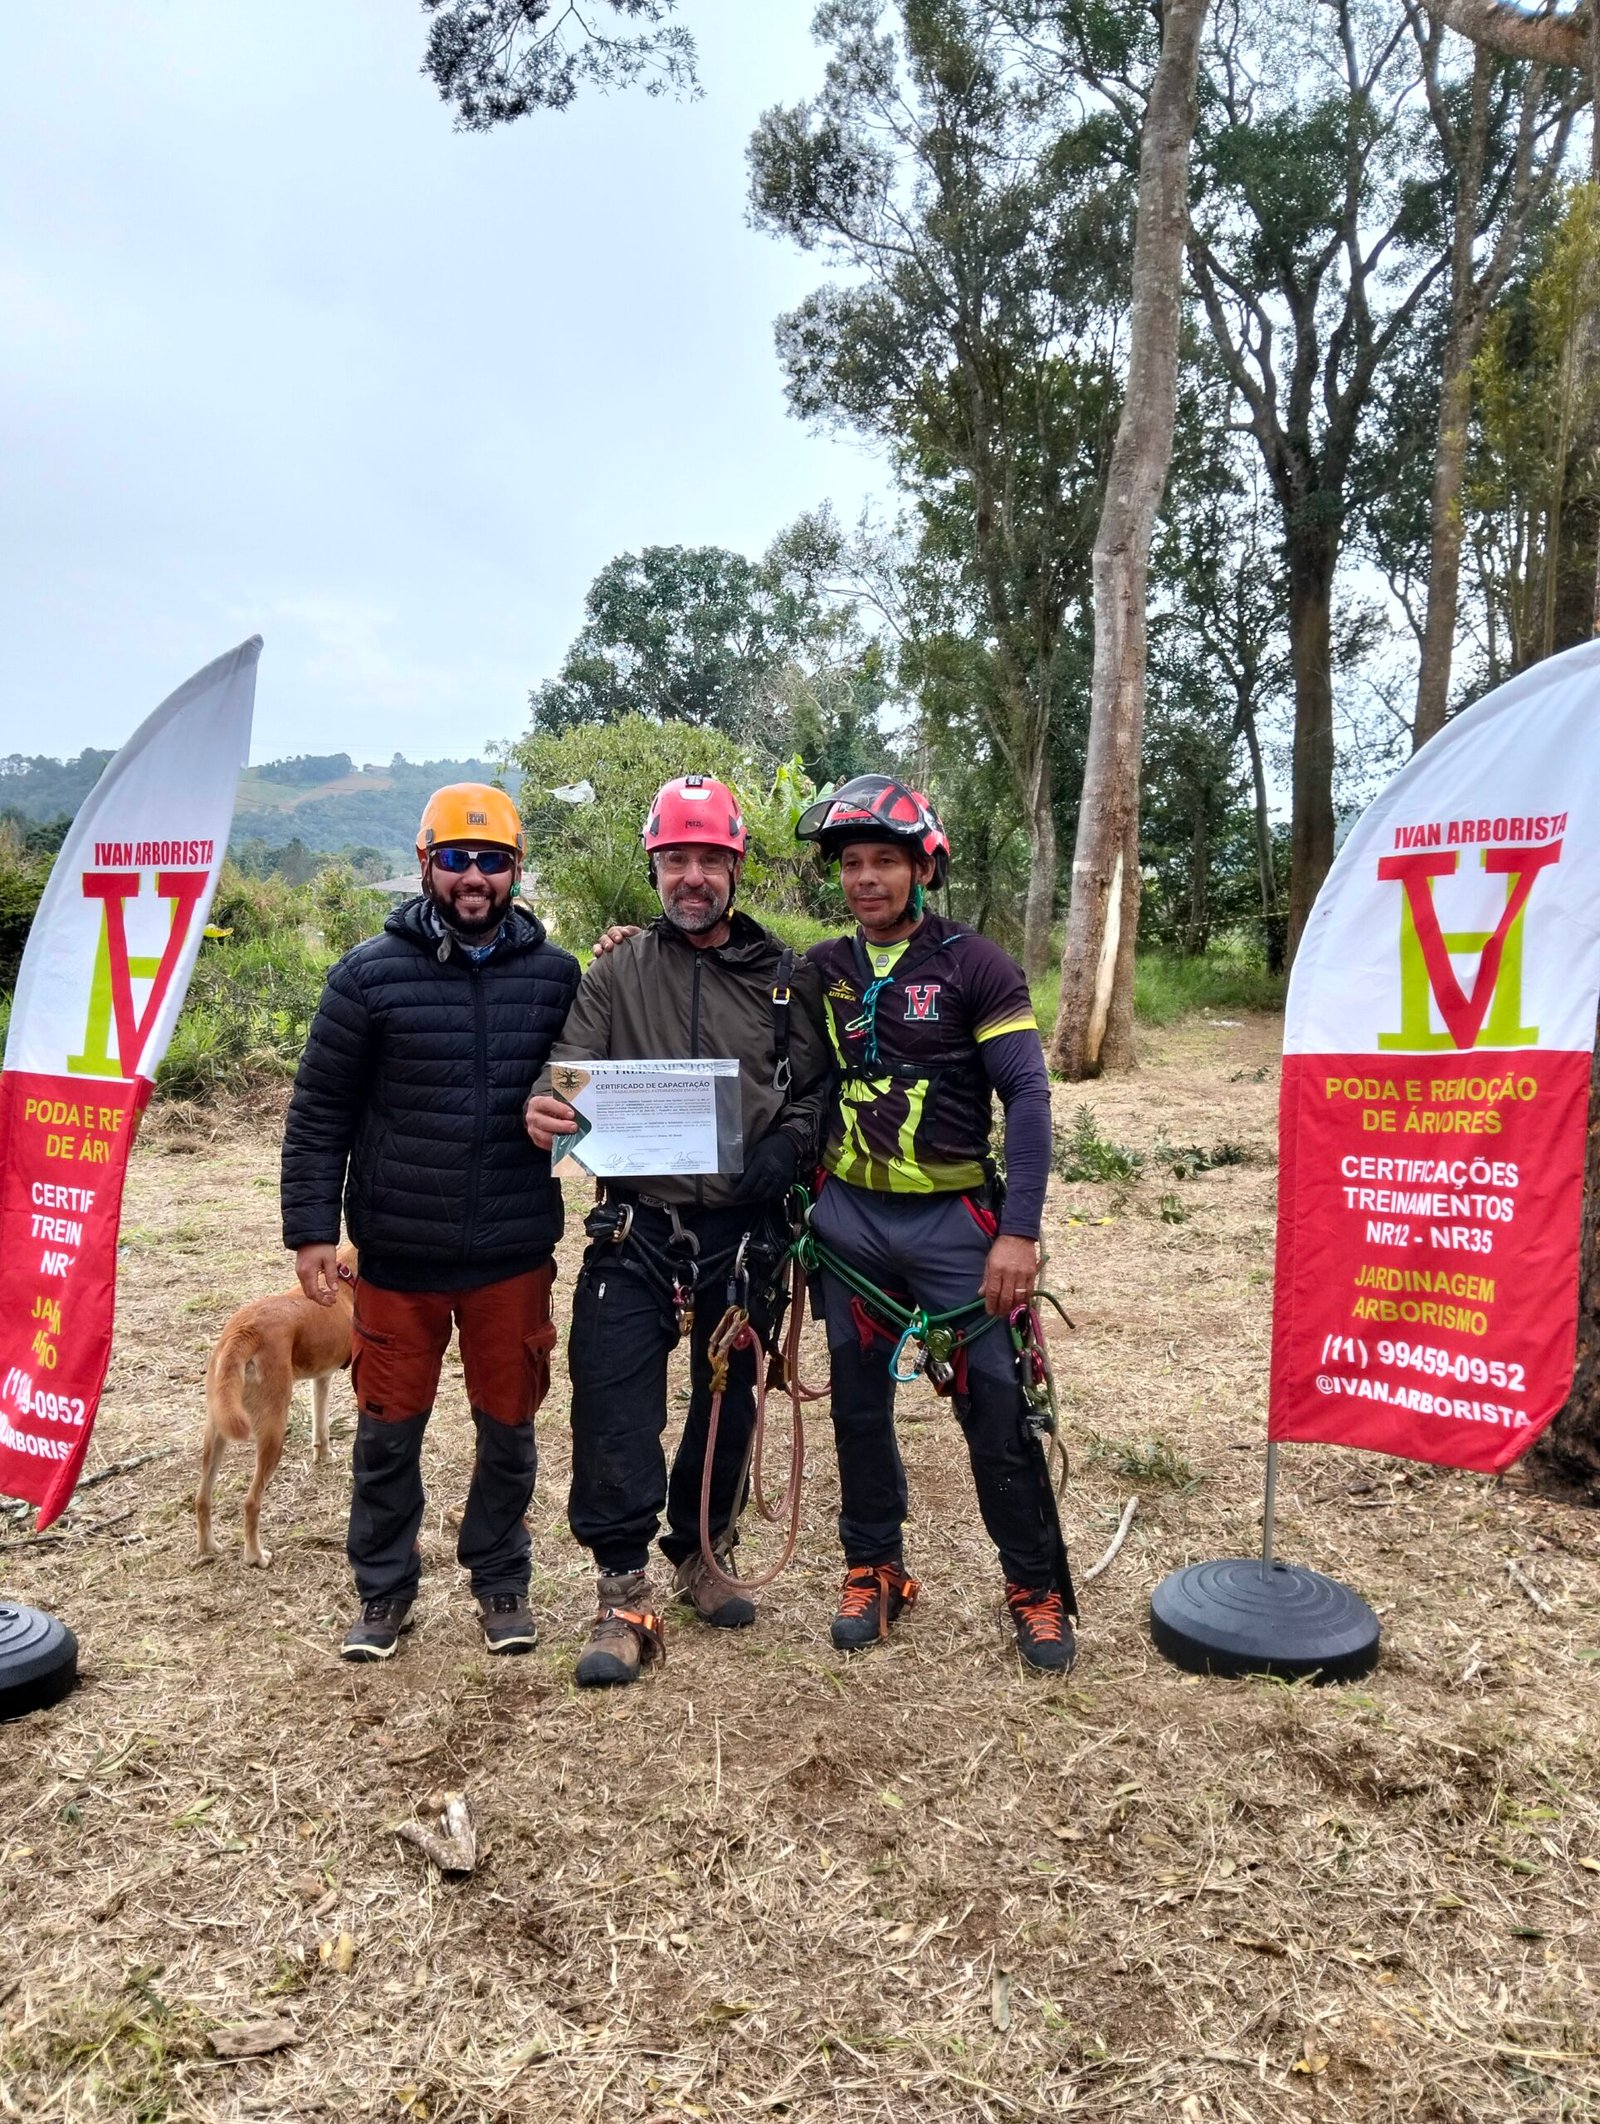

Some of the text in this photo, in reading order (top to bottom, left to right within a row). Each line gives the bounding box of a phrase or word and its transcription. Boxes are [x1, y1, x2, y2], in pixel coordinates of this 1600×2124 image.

[1394, 811, 1568, 849] IVAN ARBORISTA
[94, 840, 213, 866] IVAN ARBORISTA
[657, 1080, 710, 1089] CAPACITAÇÃO
[1325, 1077, 1400, 1100] PODA
[1406, 1079, 1421, 1098] E
[25, 1098, 80, 1127] PODA
[85, 1106, 95, 1129] E
[1362, 1109, 1396, 1132] DE
[46, 1134, 75, 1159] DE
[1341, 1155, 1519, 1189] CERTIFICAÇÕES
[1342, 1186, 1514, 1222] TREINAMENTOS
[1366, 1220, 1408, 1247] NR12
[1430, 1226, 1493, 1254] NR35
[1354, 1265, 1495, 1303] JARDINAGEM
[1352, 1297, 1488, 1336] ARBORISMO
[1321, 1334, 1526, 1392] (11) 99459-0952
[1316, 1375, 1531, 1429] @IVAN.ARBORISTA
